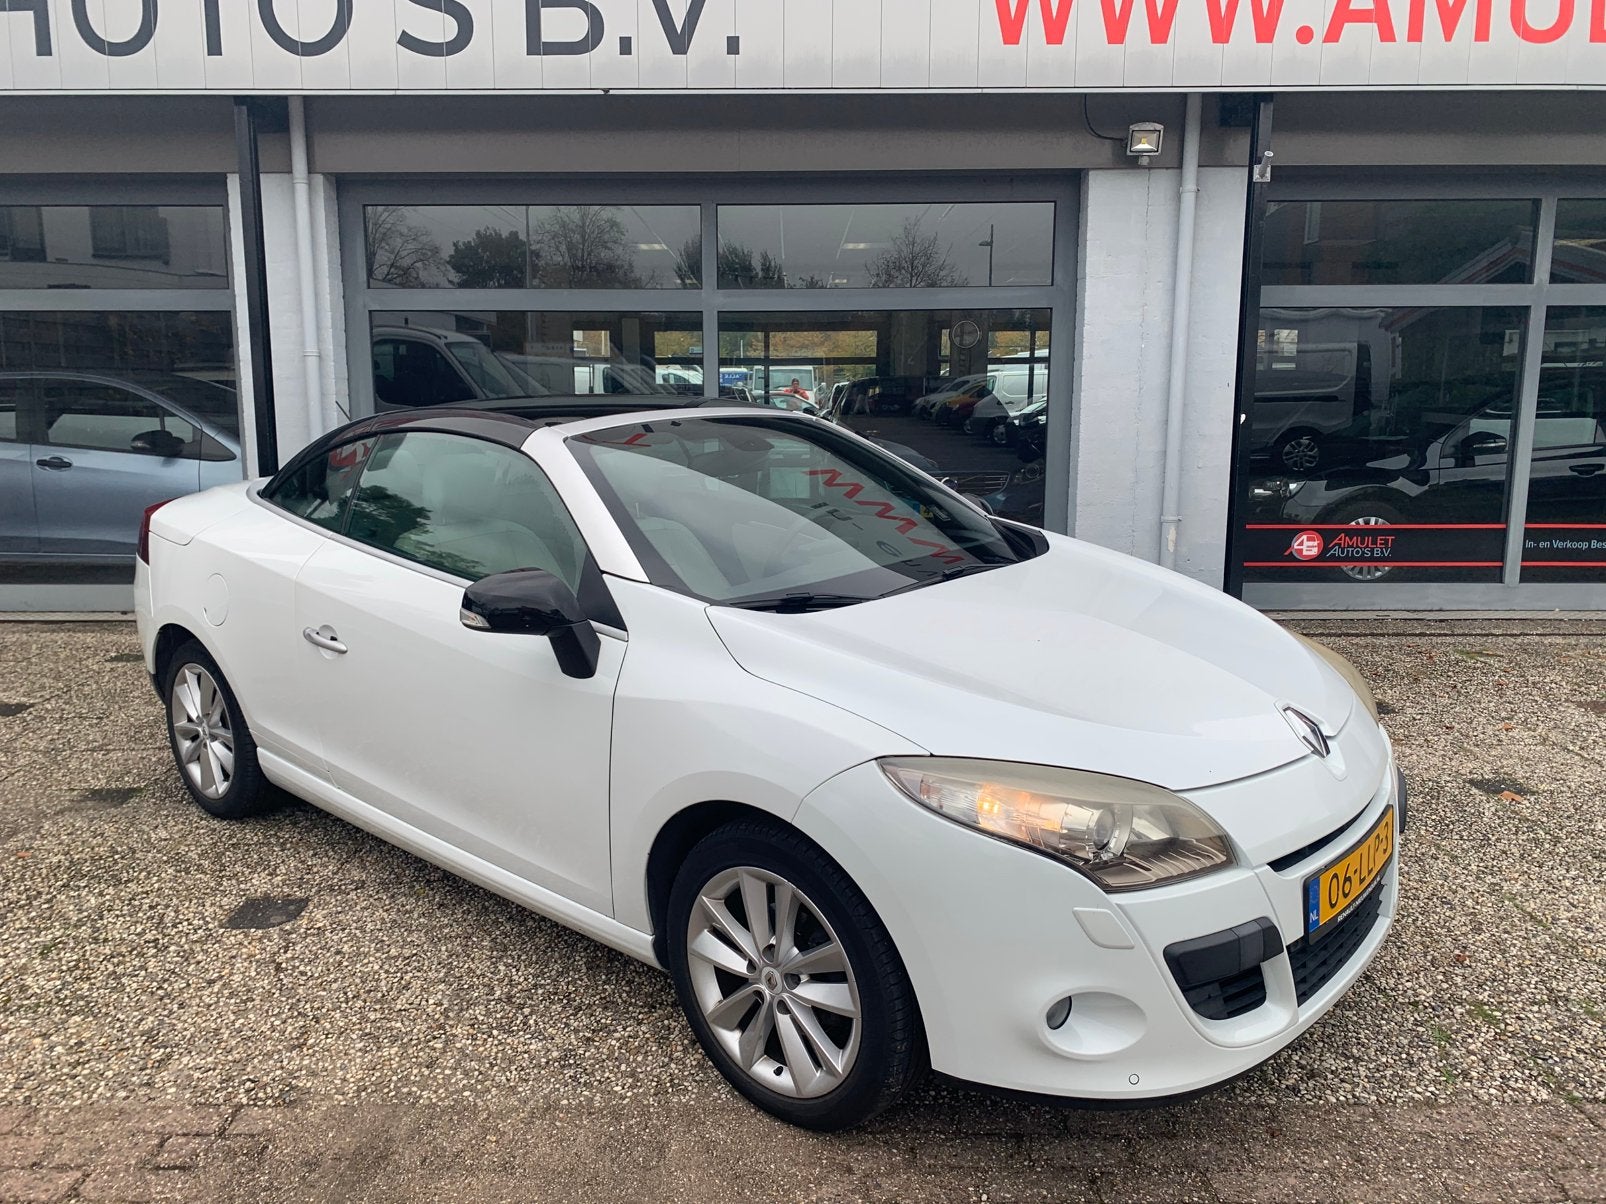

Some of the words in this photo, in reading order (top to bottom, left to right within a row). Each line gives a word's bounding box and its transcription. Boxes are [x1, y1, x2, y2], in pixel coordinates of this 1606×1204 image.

[995, 0, 1606, 45] WWW.AMU
[1327, 532, 1396, 548] AMULET
[1538, 541, 1550, 549] en
[1552, 539, 1589, 551] Verkoop
[1326, 545, 1371, 557] AUTO'S
[1373, 547, 1392, 557] B.V.
[1328, 821, 1389, 909] 06-LLP-3
[1309, 911, 1319, 924] NL
